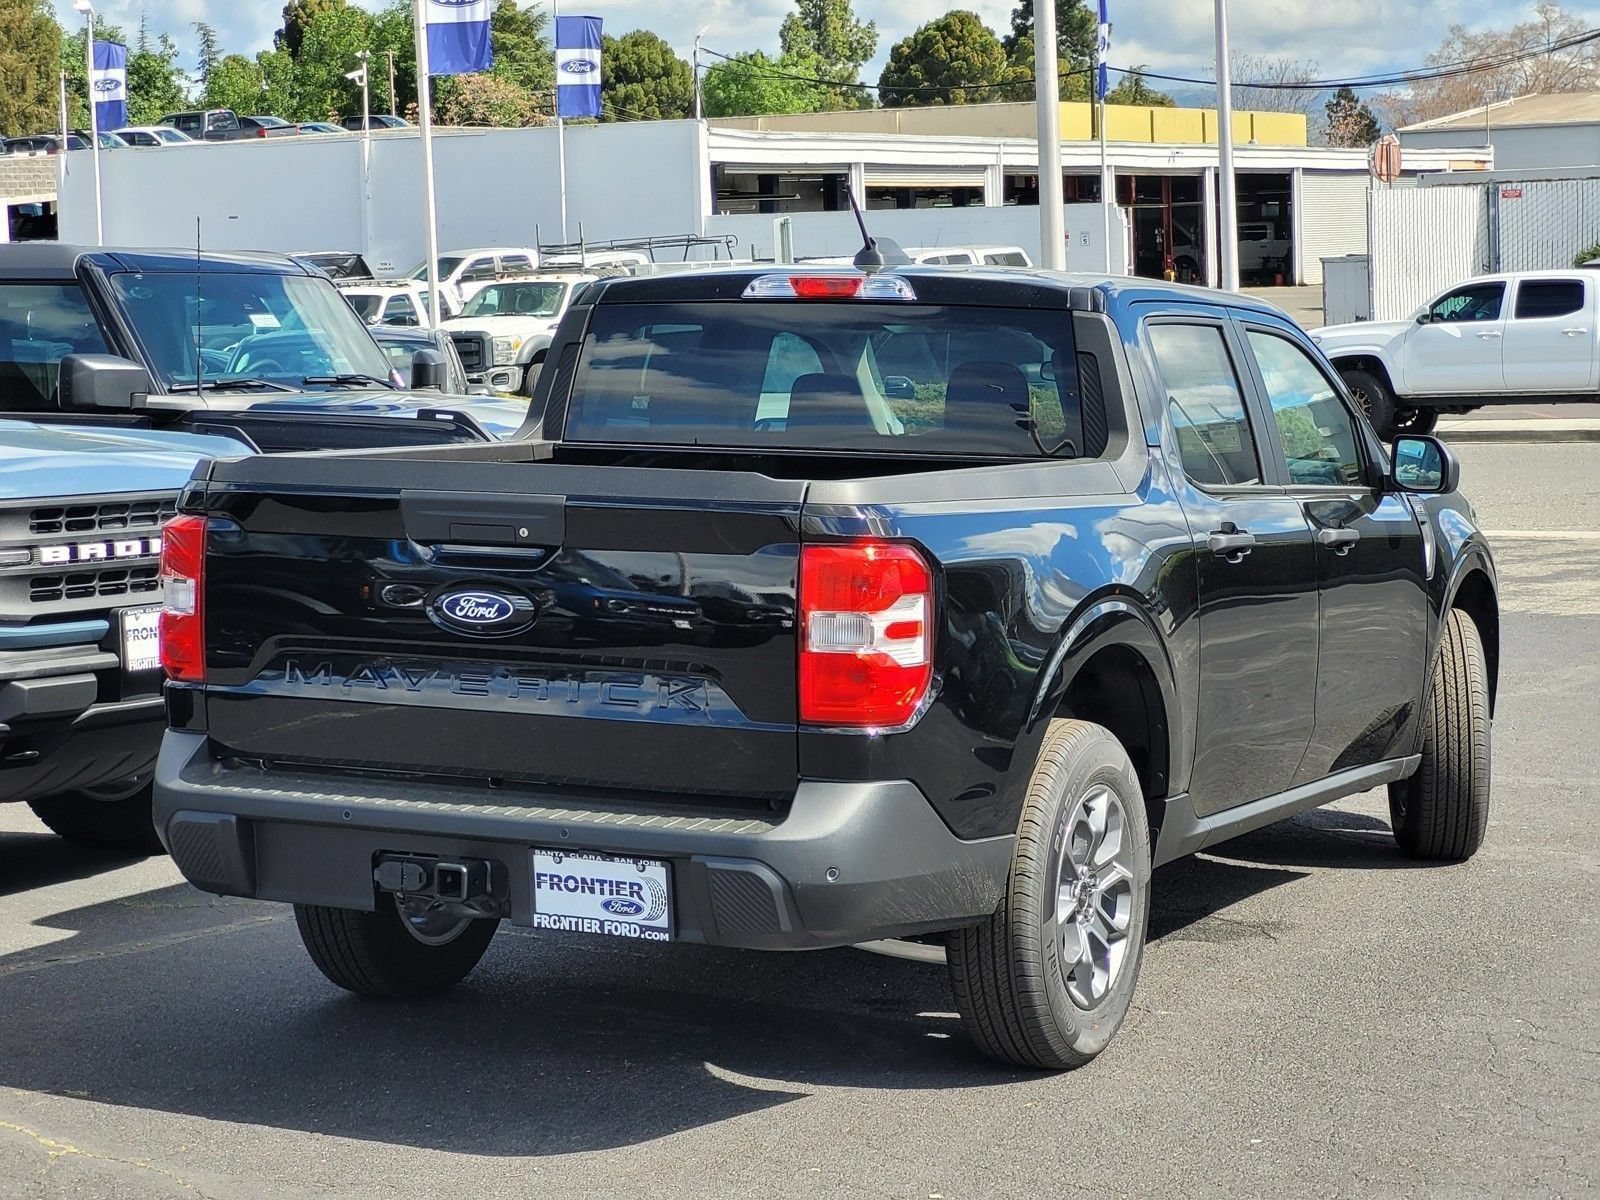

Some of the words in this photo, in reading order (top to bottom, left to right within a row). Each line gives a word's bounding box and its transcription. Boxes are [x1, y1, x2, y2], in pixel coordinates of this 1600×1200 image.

[566, 60, 592, 73] Ford
[455, 596, 500, 618] Ford
[127, 625, 159, 641] FRON
[284, 658, 711, 713] MAVERICK
[569, 852, 602, 861] CLARA
[613, 857, 634, 865] SAN
[638, 859, 662, 867] JOSE
[536, 872, 647, 904] FRONTIER
[608, 900, 636, 914] Ford
[533, 913, 601, 934] FRONTIER
